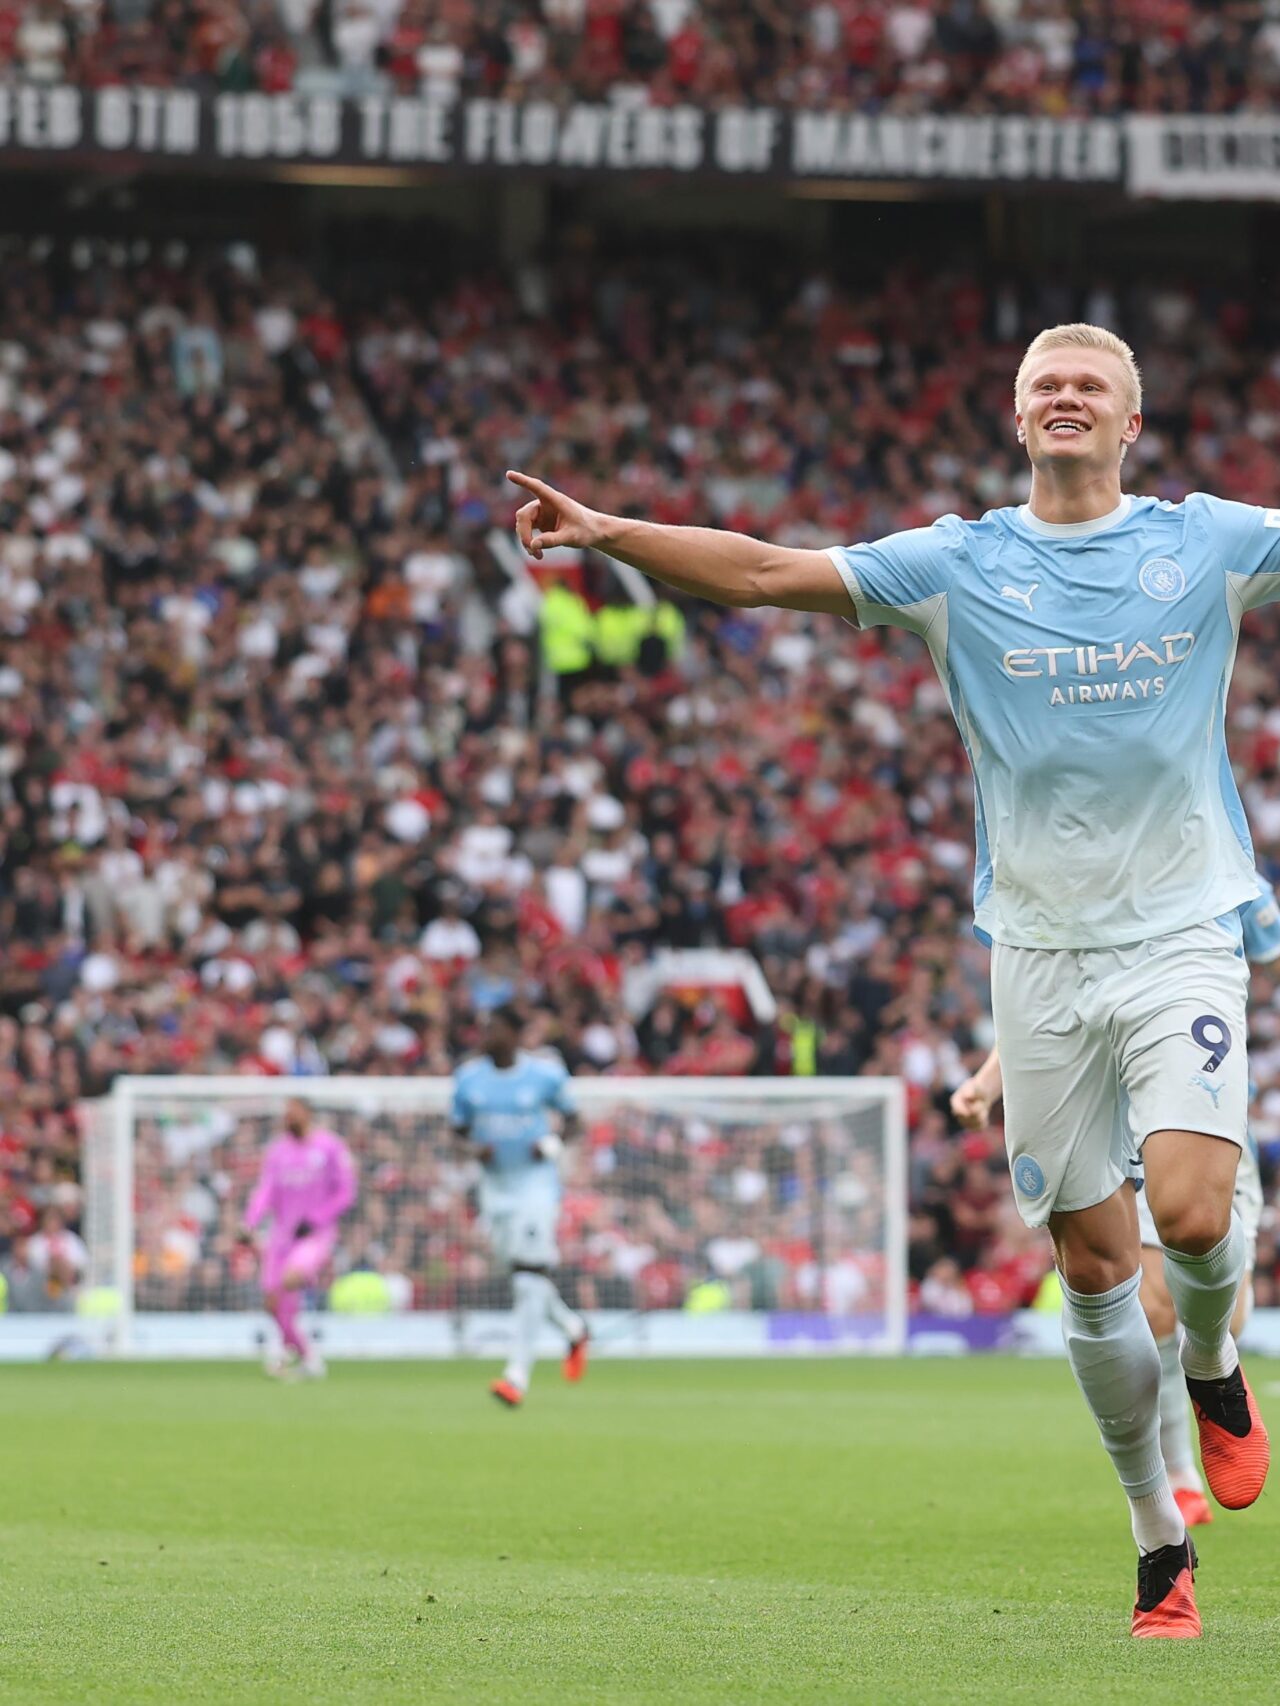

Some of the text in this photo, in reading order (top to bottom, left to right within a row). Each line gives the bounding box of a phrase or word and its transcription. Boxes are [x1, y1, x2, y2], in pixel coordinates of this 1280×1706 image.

[359, 98, 455, 163] THE
[465, 101, 701, 170] FLOWERS
[713, 106, 780, 172] OF
[794, 108, 1121, 182] MANCHESTER
[1003, 631, 1196, 677] ETIHAD
[1050, 676, 1166, 707] AIRWAYS
[1190, 1014, 1232, 1073] 9
